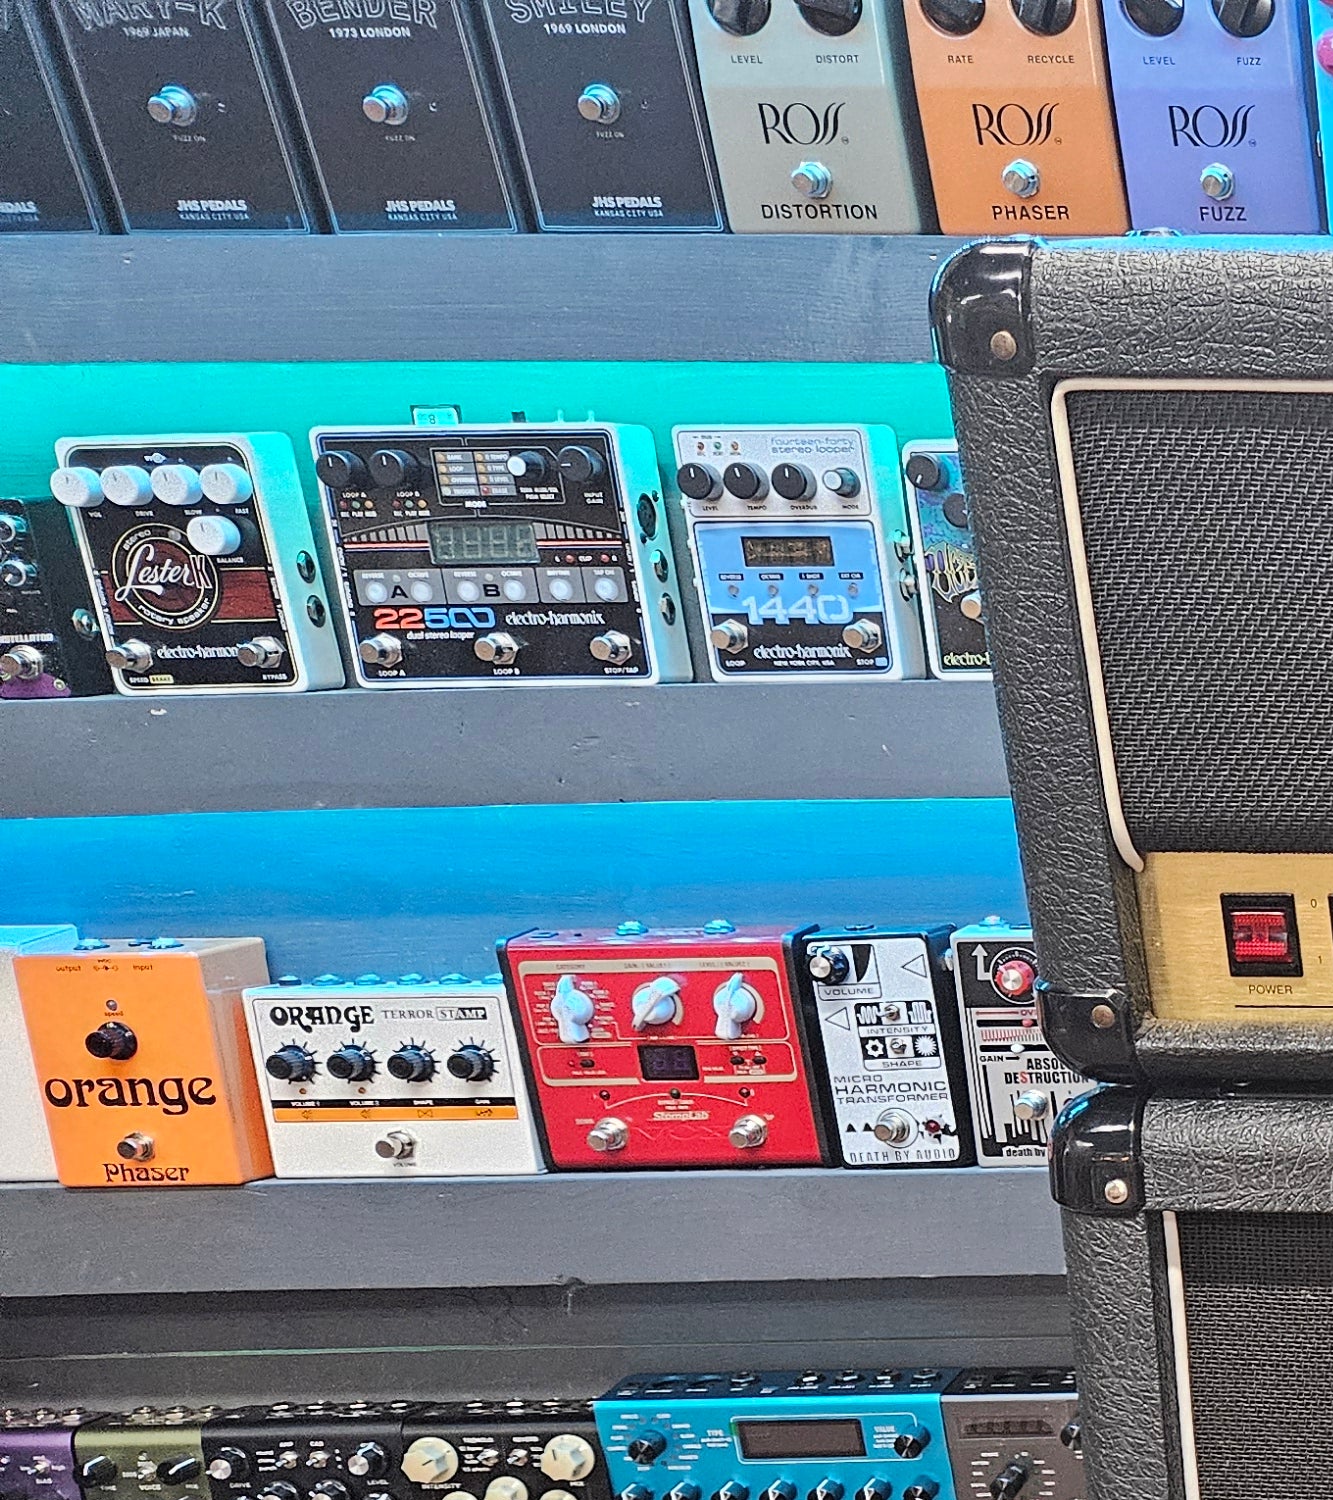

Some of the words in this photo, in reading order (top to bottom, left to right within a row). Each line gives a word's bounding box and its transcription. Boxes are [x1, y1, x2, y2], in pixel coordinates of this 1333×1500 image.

[152, 26, 190, 38] JAPAN
[328, 27, 359, 38] 1973
[360, 26, 411, 38] LONDON
[543, 23, 574, 35] 1969
[574, 23, 627, 35] LONDON
[730, 54, 764, 65] LEVEL
[815, 53, 860, 64] DISTORT
[947, 55, 975, 65] RATE
[1027, 54, 1076, 65] RECYCLE
[1142, 55, 1176, 66] LEVEL
[1236, 56, 1262, 66] FUZZ
[757, 102, 847, 146] ROSS
[971, 102, 1057, 146] ROSS
[1168, 104, 1257, 148] ROSS
[176, 199, 201, 212] JHS
[201, 199, 248, 212] PEDALS
[385, 199, 409, 213] JHS
[409, 199, 456, 213] PEDALS
[592, 195, 616, 209] JHS
[616, 196, 663, 210] PEDALS
[760, 204, 879, 221] DISTORTION
[992, 205, 1071, 221] PHASER
[1199, 206, 1247, 222] FUZZ
[123, 529, 152, 551] stereo
[115, 543, 194, 602] Lester
[137, 604, 175, 626] rotary
[177, 597, 210, 626] speaker
[742, 594, 854, 625] 1440
[373, 607, 497, 630] 22500
[450, 630, 475, 641] looper
[753, 644, 853, 660] electro-harmonix
[823, 987, 875, 996] VOLUME
[1247, 984, 1293, 996] POWER
[268, 1005, 375, 1033] ORANGE
[381, 1008, 434, 1020] TERROR
[438, 1006, 487, 1020] STAMP
[866, 1026, 929, 1035] INTENSITY
[881, 1059, 923, 1068] SHAPE
[979, 1055, 1005, 1063] GAIN
[833, 1075, 883, 1083] MICRO
[835, 1081, 948, 1095] HARMONIC
[44, 1076, 217, 1116] orange
[836, 1092, 949, 1105] TRANSFORMER
[849, 1150, 891, 1163] DEATH
[894, 1149, 911, 1161] BY
[915, 1148, 957, 1160] AUDIO
[1005, 1148, 1031, 1157] death
[1033, 1147, 1046, 1157] by
[102, 1163, 190, 1183] Phaser
